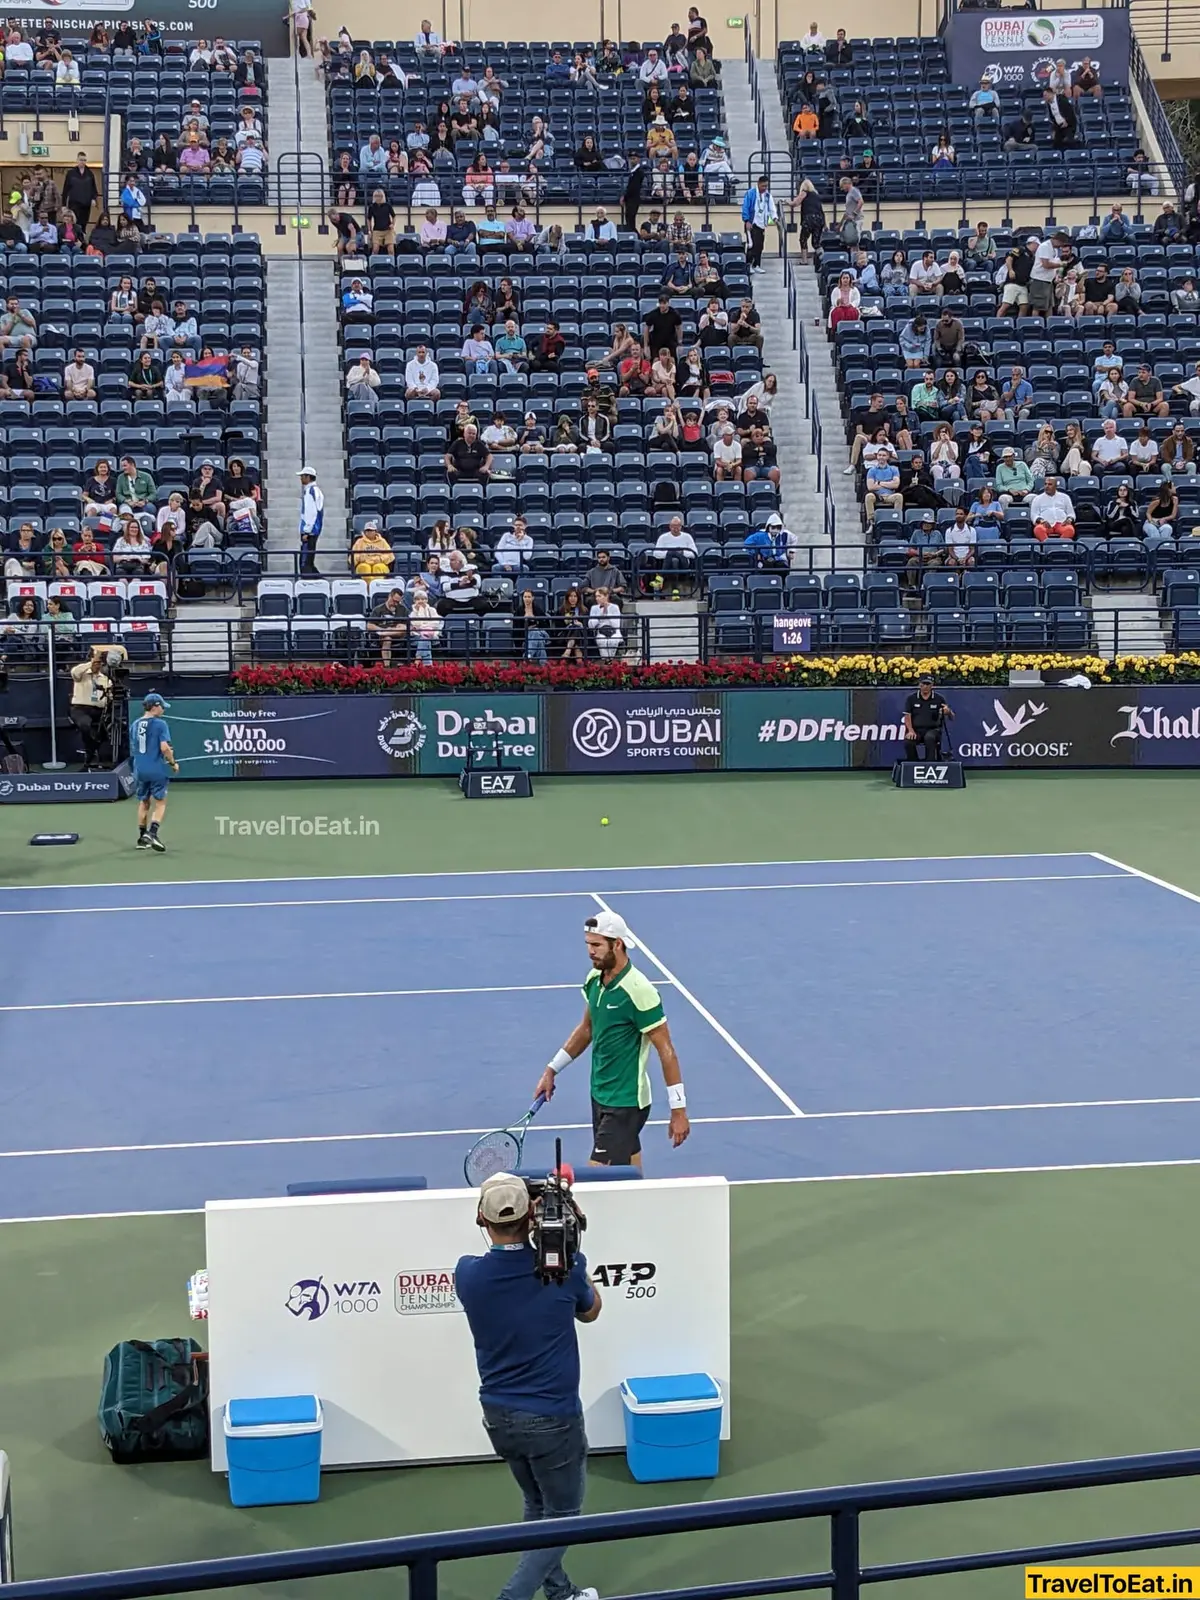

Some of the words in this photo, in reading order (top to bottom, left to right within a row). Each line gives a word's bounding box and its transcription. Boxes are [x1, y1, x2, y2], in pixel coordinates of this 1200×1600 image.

[984, 20, 1025, 31] DUBAI
[985, 35, 1025, 43] TENNIS
[1003, 65, 1025, 74] WTA
[1003, 73, 1023, 81] 1000
[782, 632, 802, 645] 1:26
[211, 710, 236, 718] Dubai
[237, 710, 257, 718] Duty
[258, 709, 277, 717] Free
[626, 706, 663, 718] الرياضي
[664, 708, 686, 717] دبي
[687, 706, 721, 717] مجلس
[223, 724, 267, 739] Win
[626, 718, 721, 744] DUBAI
[758, 716, 907, 742] #DDFtenni
[204, 739, 286, 753] $1,000,000
[377, 735, 394, 755] DUBAI
[394, 749, 414, 758] DUTY
[414, 734, 426, 751] FREE
[626, 747, 671, 757] SPORTS
[673, 746, 721, 756] COUNCIL
[958, 743, 1003, 757] GREY
[913, 766, 948, 779] EA7
[17, 783, 51, 792] Dubai
[54, 782, 82, 792] Duty
[85, 781, 110, 790] Free
[481, 775, 515, 789] EA7
[399, 1273, 456, 1287] DUBAI
[592, 1262, 656, 1287] ATP
[333, 1282, 381, 1296] WTA
[400, 1286, 429, 1295] DUTY
[431, 1284, 456, 1293] FREE
[626, 1286, 656, 1299] 500
[400, 1292, 456, 1305] TENNIS
[333, 1298, 378, 1314] 1000
[400, 1302, 456, 1311] CHAMPIONSHIPS
